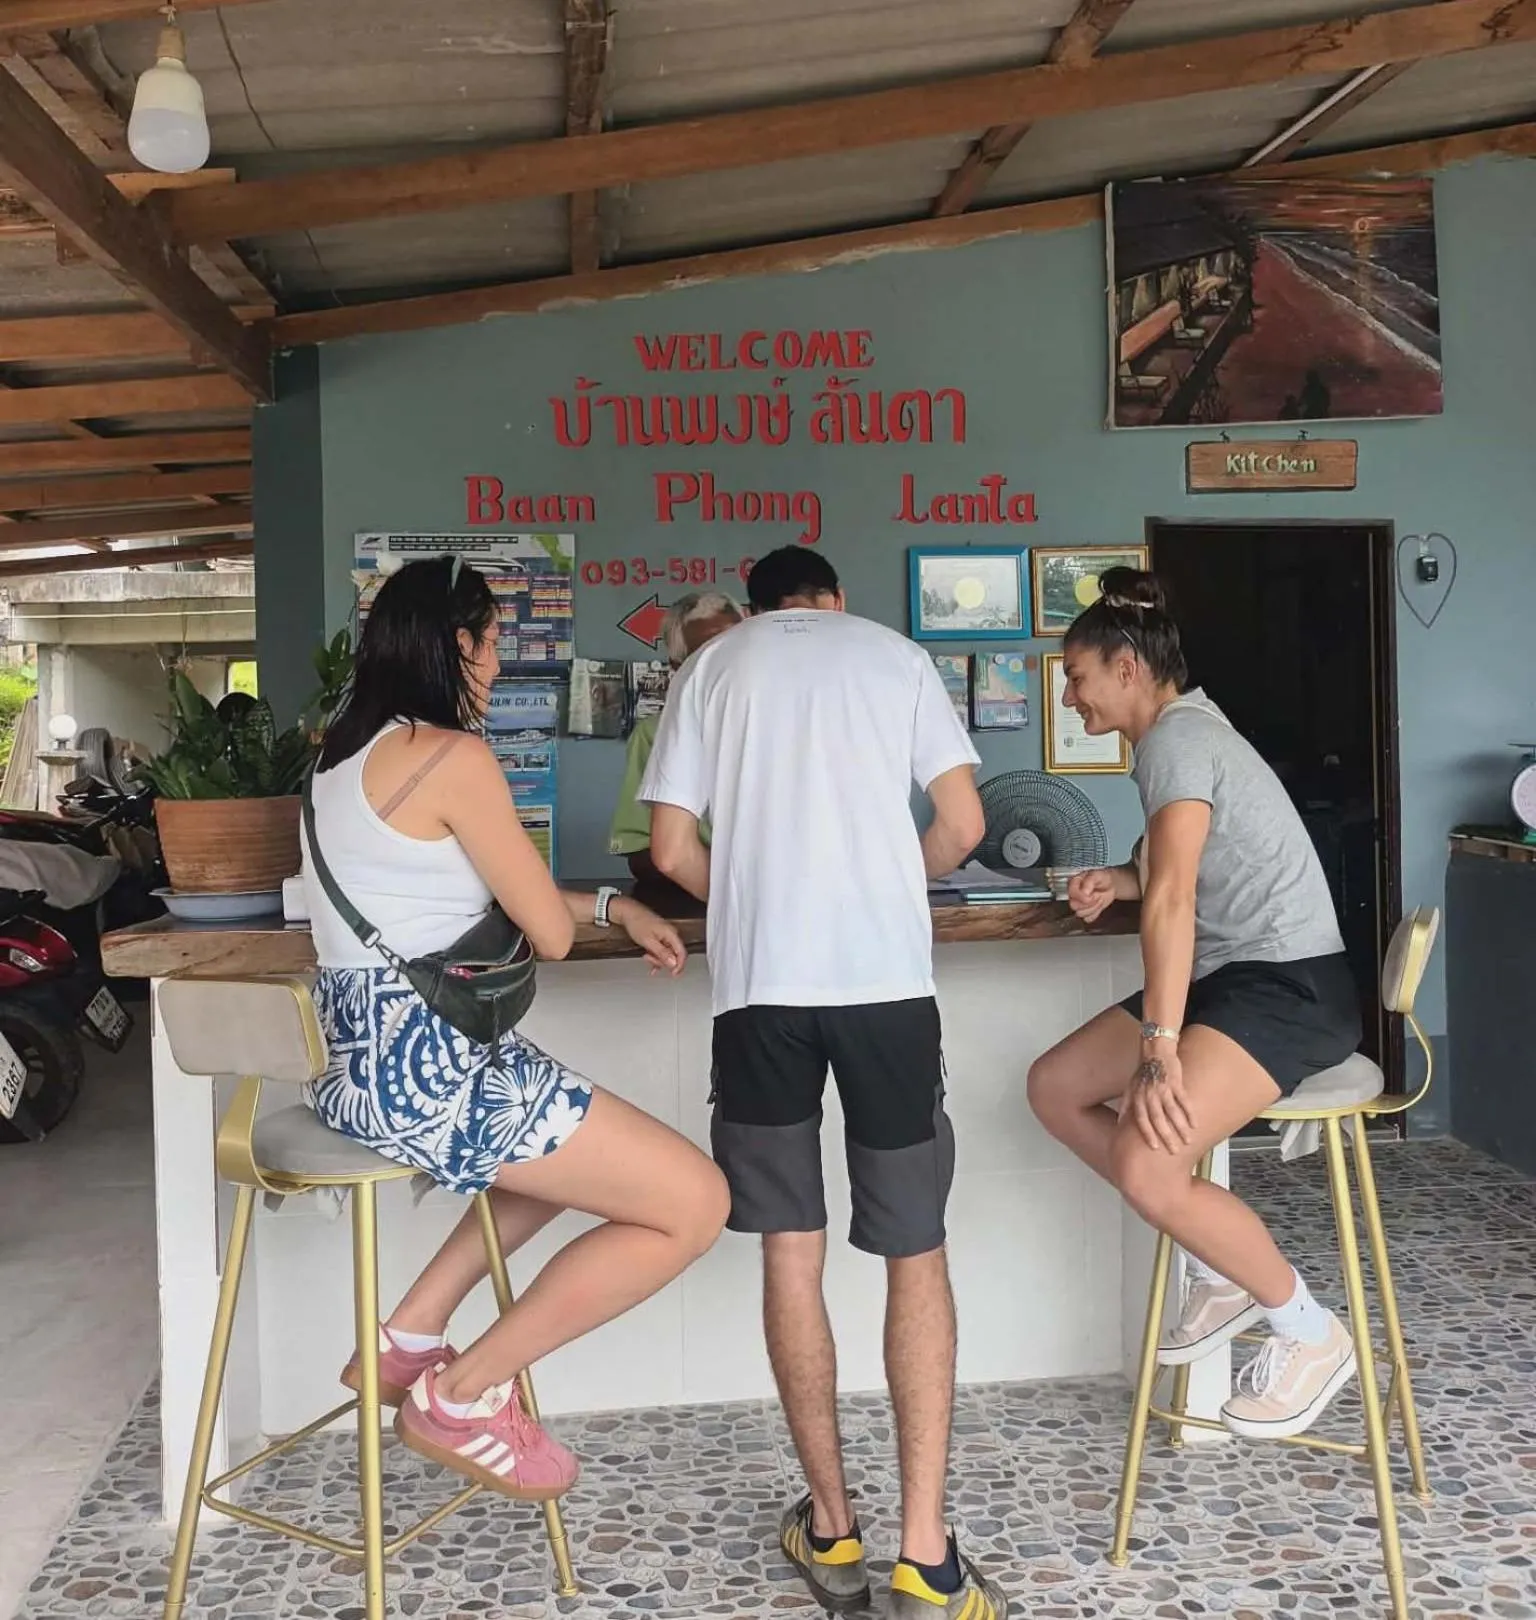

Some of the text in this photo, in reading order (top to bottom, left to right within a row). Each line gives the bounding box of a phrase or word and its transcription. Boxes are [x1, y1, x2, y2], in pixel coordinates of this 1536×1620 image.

[633, 329, 875, 372] WELCOME
[464, 471, 1038, 544] Baan Phong Lanta
